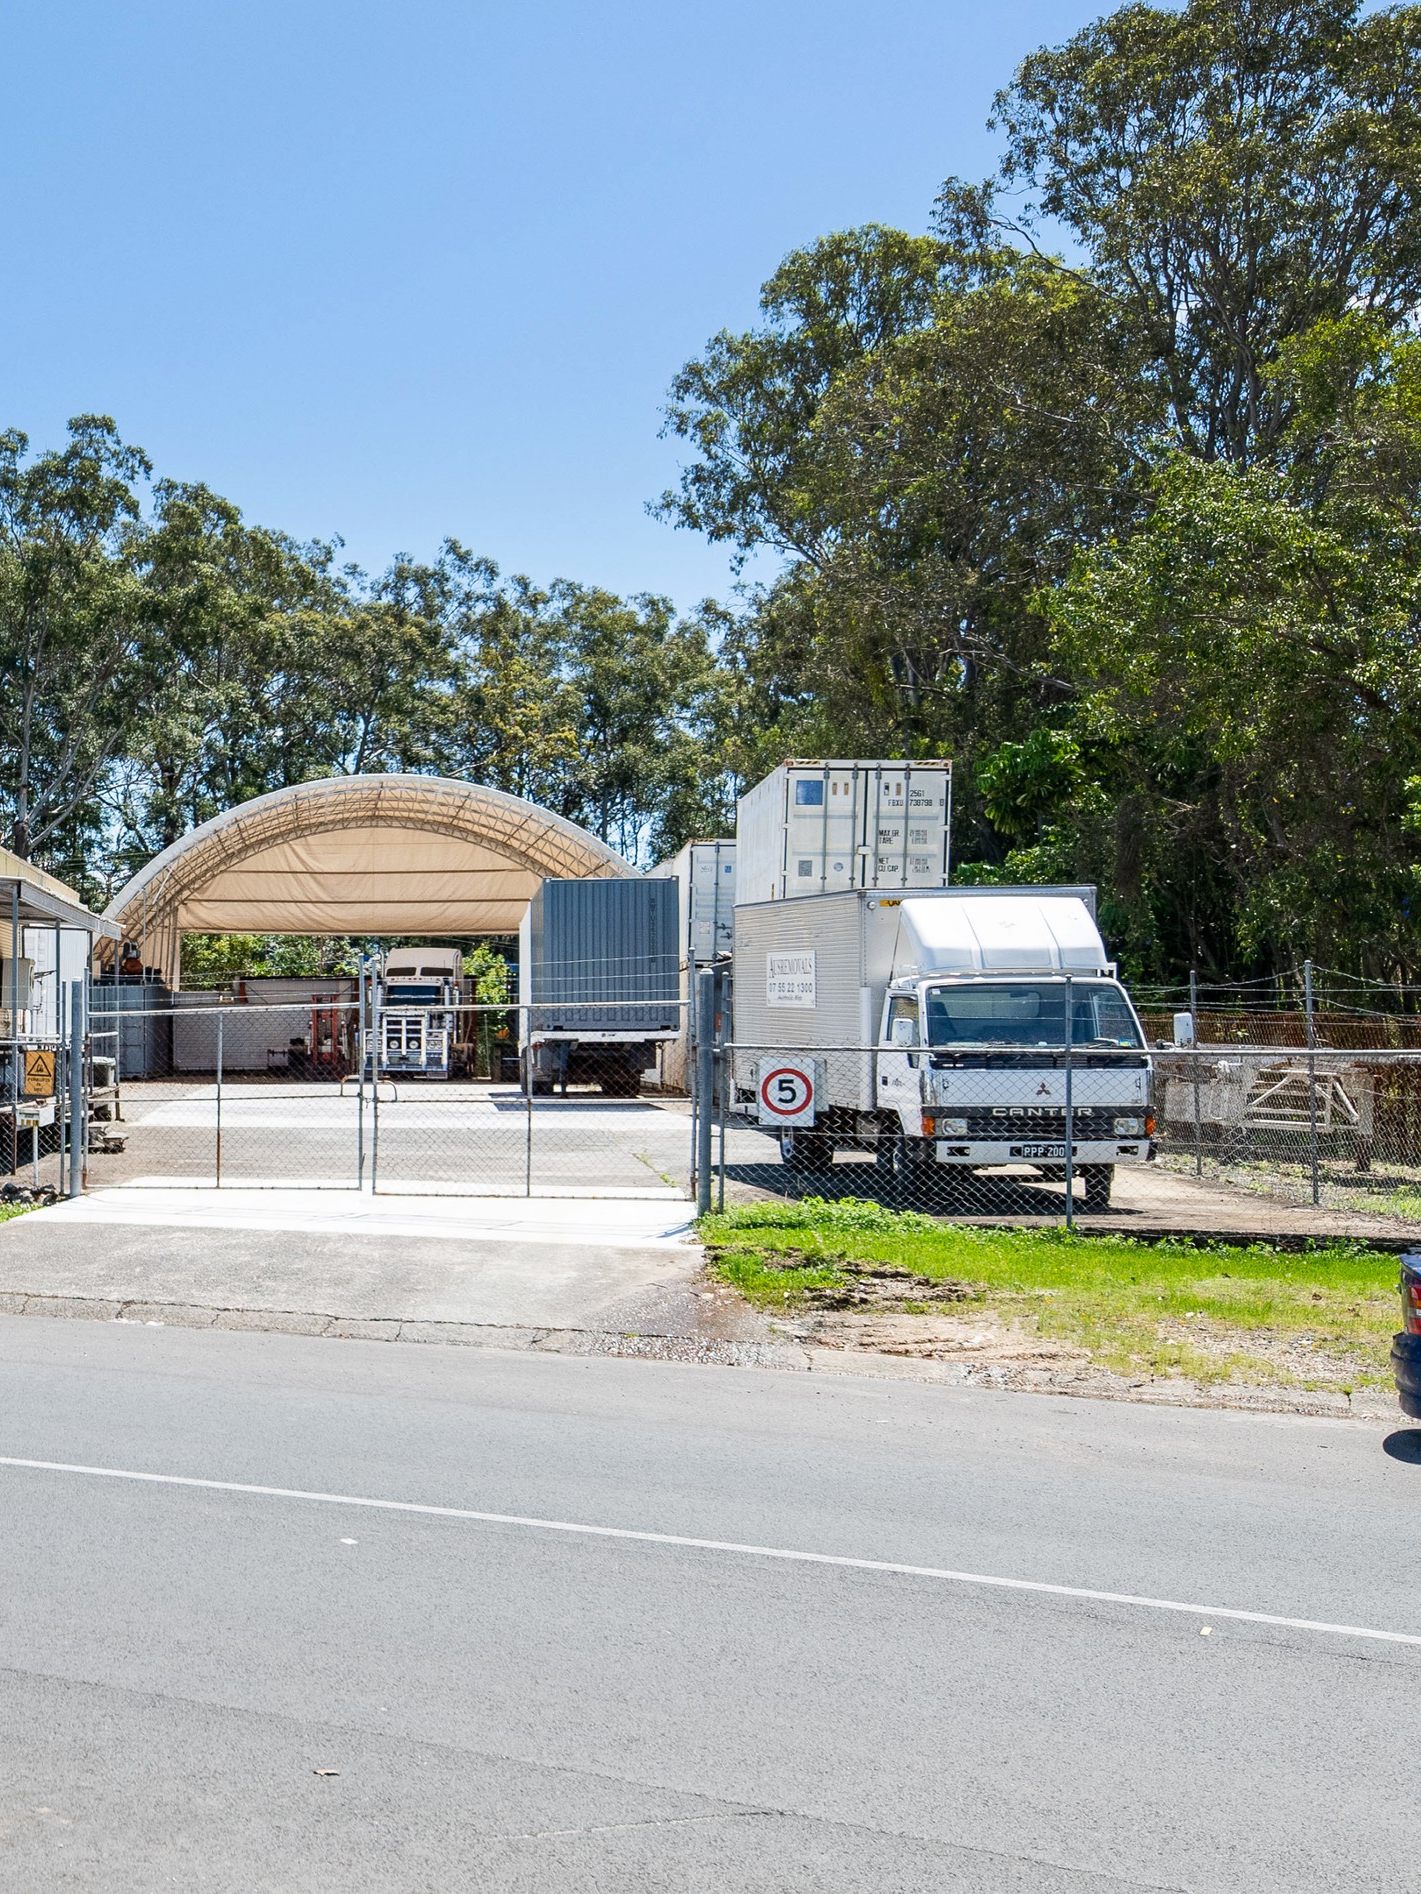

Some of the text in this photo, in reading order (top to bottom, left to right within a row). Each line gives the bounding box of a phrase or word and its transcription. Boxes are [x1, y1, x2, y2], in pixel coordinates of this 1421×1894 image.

[778, 982, 786, 993] 55
[787, 982, 795, 993] 22
[778, 1078, 797, 1104] 5
[992, 1107, 1093, 1117] CANTER
